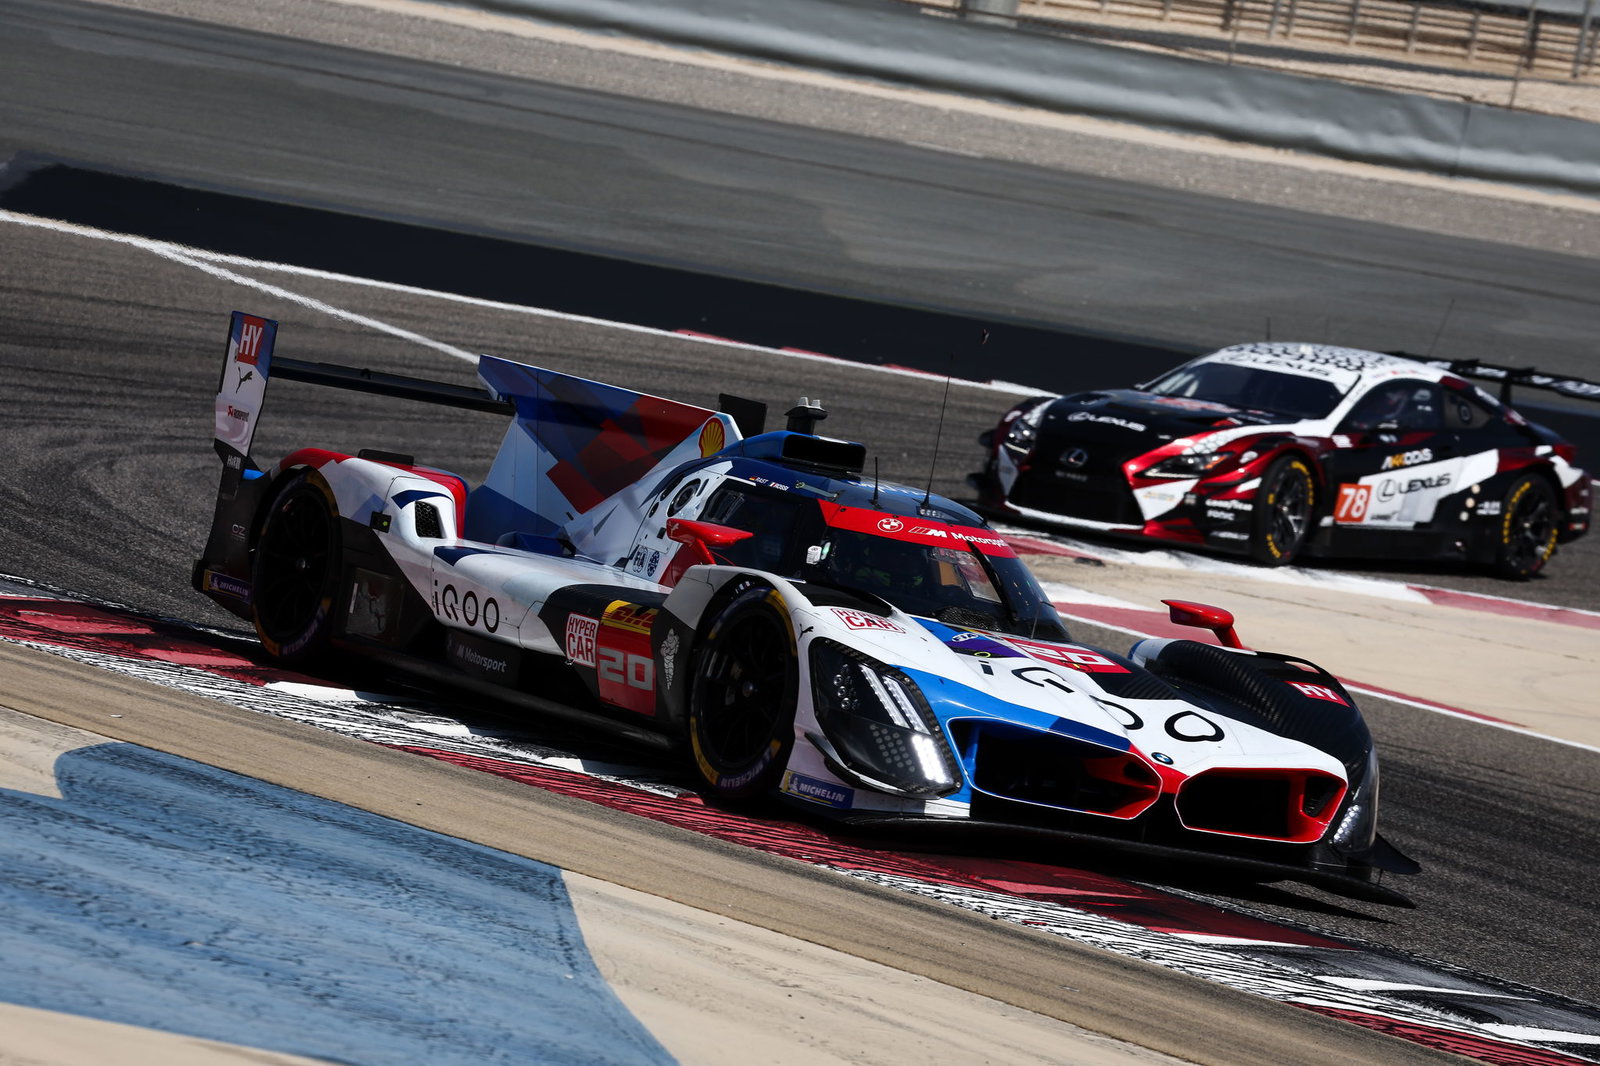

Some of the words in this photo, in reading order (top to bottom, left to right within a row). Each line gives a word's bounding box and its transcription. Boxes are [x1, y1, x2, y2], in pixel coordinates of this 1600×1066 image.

[239, 323, 263, 357] HY
[1399, 474, 1452, 494] LEXUS
[1339, 488, 1369, 518] 78
[232, 524, 246, 537] OZ
[434, 579, 500, 634] iQOO
[569, 617, 596, 639] HYPER
[845, 616, 899, 631] CAR
[567, 633, 595, 663] CAR
[954, 632, 979, 642] FIA
[464, 647, 507, 673] Motorsport
[1013, 641, 1117, 666] 20
[599, 648, 654, 691] 20
[1291, 683, 1338, 701] HY
[799, 783, 846, 803] MICHELIN
